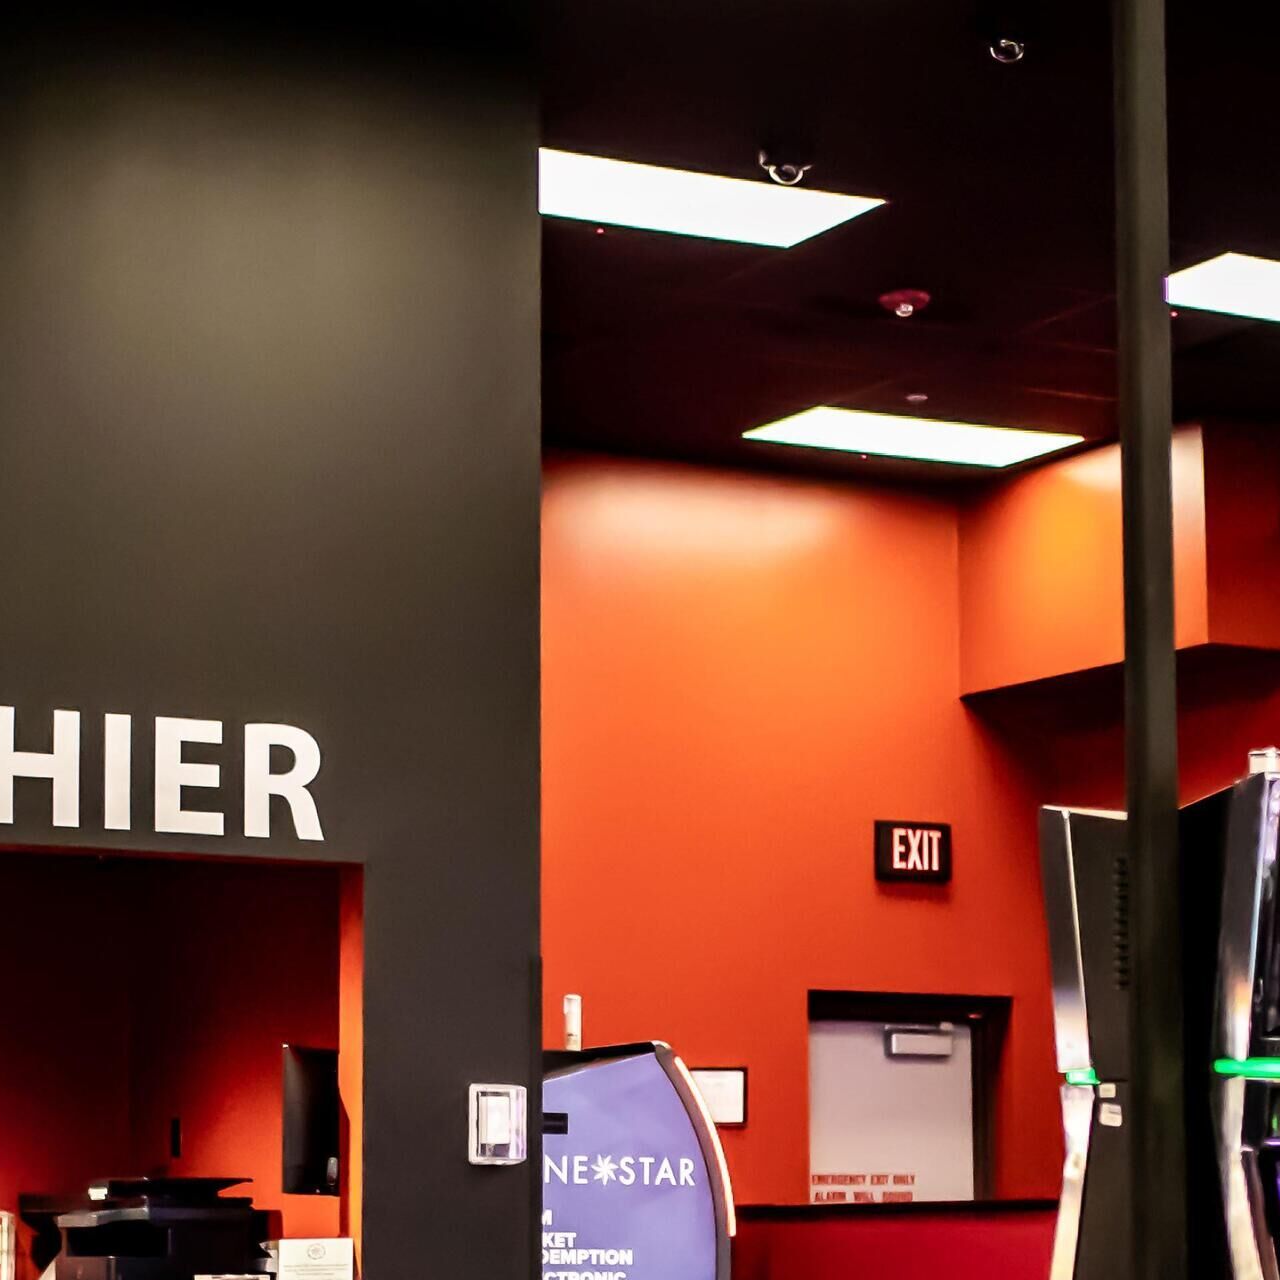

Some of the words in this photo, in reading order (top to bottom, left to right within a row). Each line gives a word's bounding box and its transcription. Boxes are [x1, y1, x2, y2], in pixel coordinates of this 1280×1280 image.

[893, 828, 941, 871] EXIT
[544, 1155, 588, 1184] NE
[619, 1157, 695, 1186] STAR
[543, 1232, 577, 1248] KET
